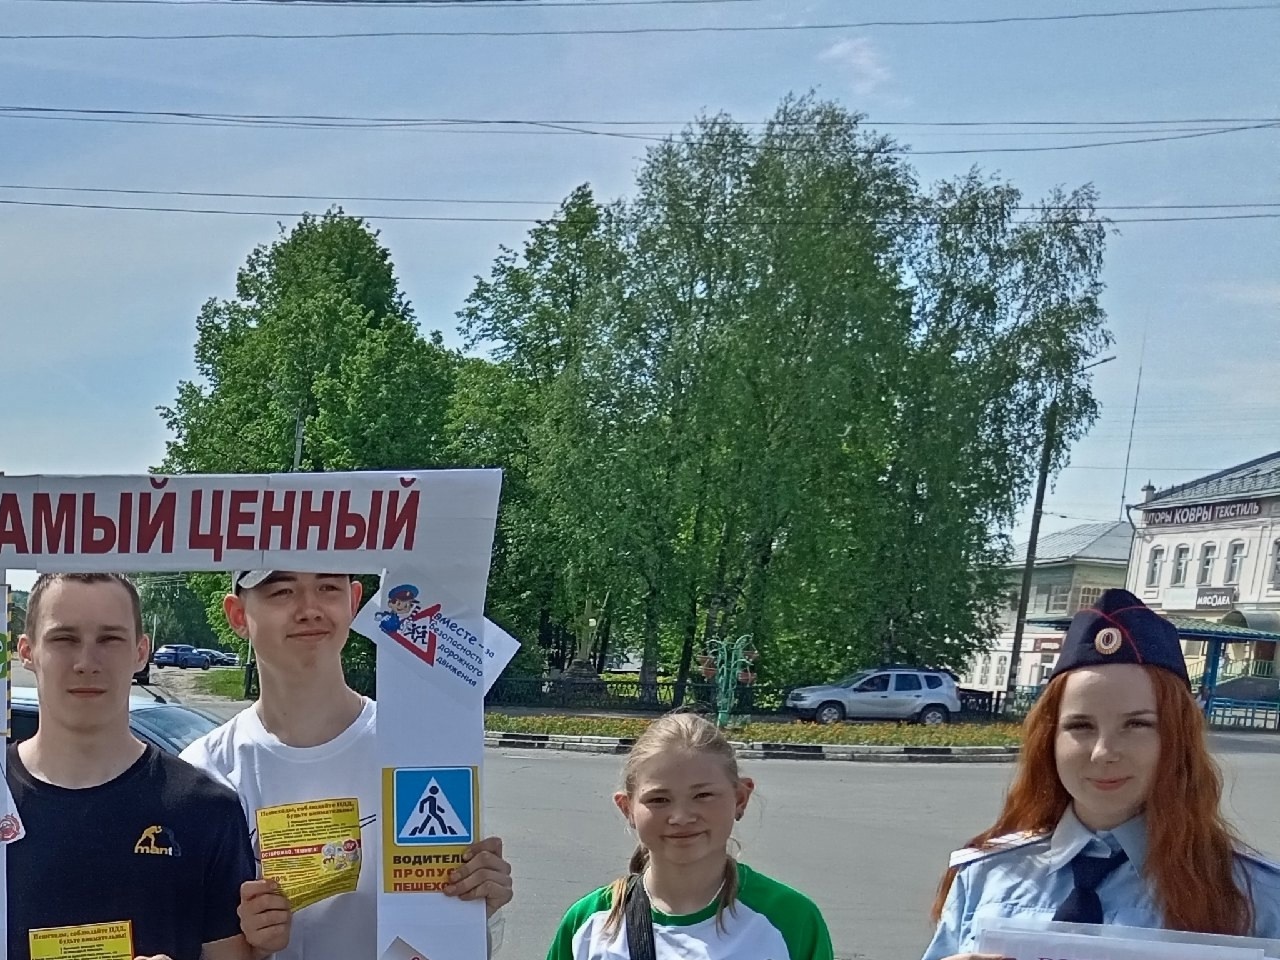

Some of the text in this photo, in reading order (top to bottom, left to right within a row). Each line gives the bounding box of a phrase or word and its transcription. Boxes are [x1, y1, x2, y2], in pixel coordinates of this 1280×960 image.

[188, 477, 422, 562] ЦЕННЫЙ
[1174, 506, 1213, 524] КОВРЫ
[1215, 502, 1259, 518] ТЕКСТИЛЬ
[429, 622, 483, 666] безопасность
[437, 643, 484, 678] дорожного
[435, 656, 478, 688] движения
